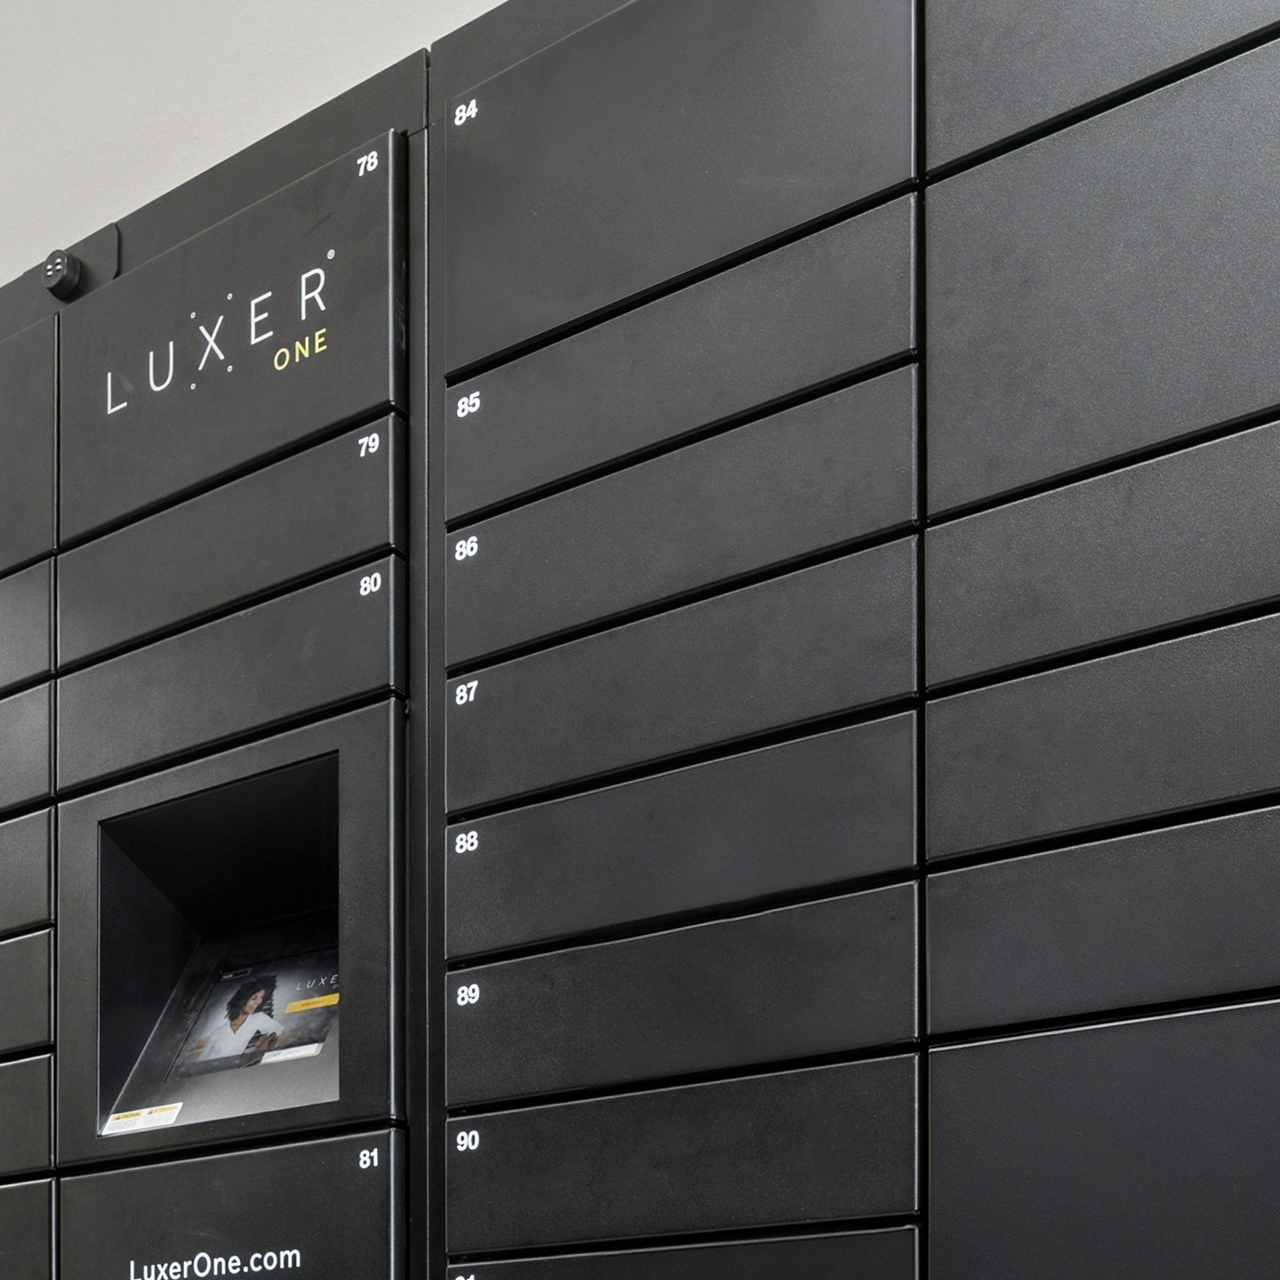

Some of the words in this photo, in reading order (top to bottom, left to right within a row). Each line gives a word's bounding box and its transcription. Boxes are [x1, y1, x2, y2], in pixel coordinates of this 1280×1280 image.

[453, 98, 479, 127] 84
[356, 150, 379, 177] 78
[106, 267, 327, 416] LUXER
[273, 327, 328, 371] ONE
[456, 390, 481, 418] 85
[357, 432, 380, 458] 79
[454, 535, 479, 562] 86
[359, 571, 382, 597] 80
[454, 679, 479, 706] 87
[454, 830, 480, 855] 88
[295, 974, 339, 991] LUXE
[456, 982, 481, 1007] 89
[455, 1129, 481, 1152] 90
[358, 1147, 379, 1170] 81
